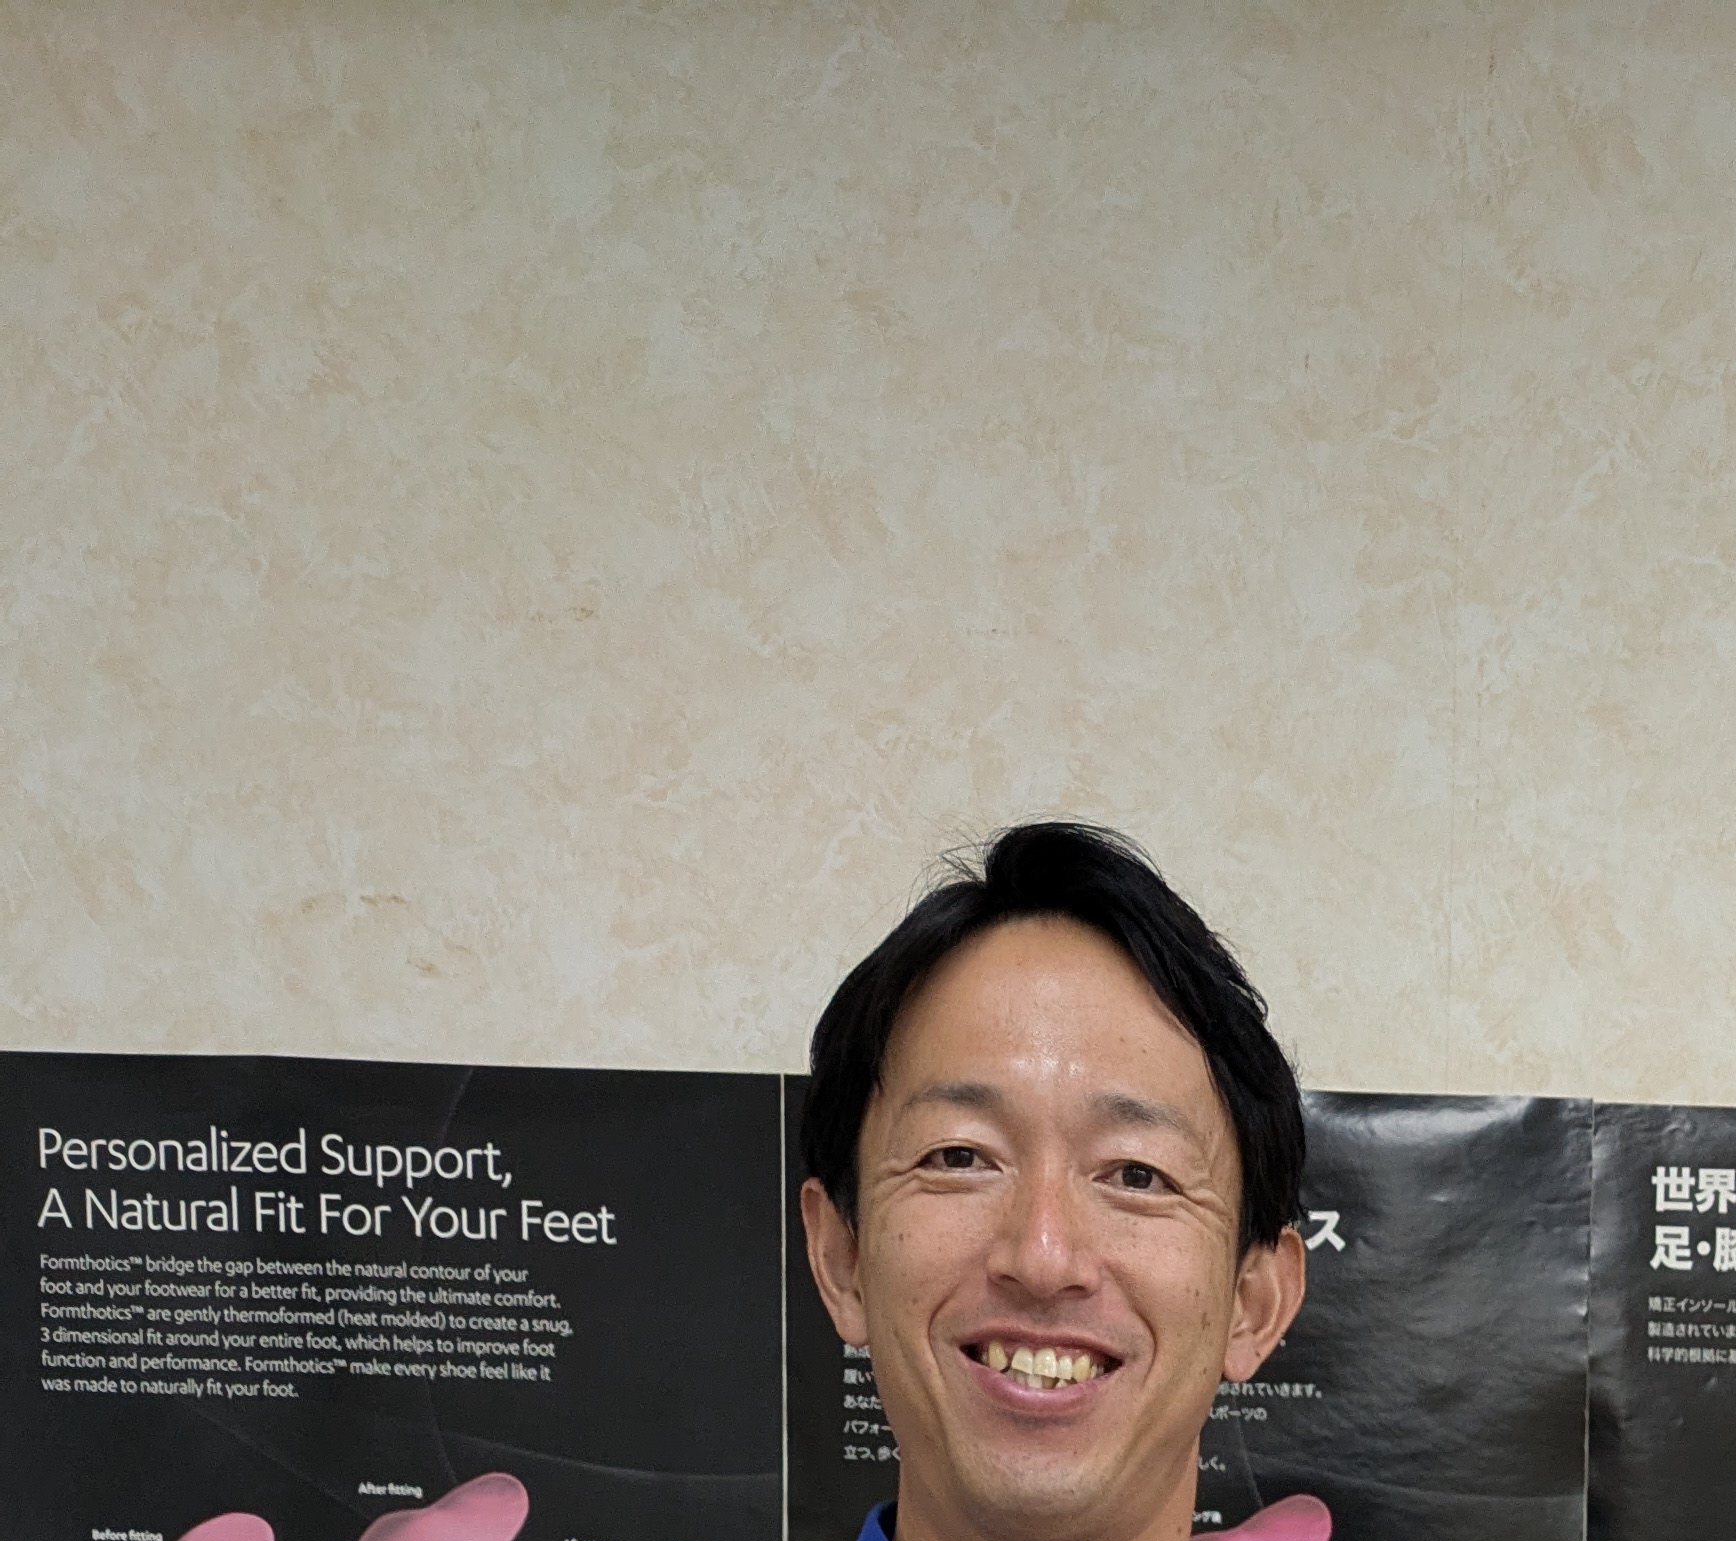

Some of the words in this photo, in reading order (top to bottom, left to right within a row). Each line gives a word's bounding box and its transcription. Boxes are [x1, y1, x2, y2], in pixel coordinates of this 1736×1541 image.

[38, 1125, 307, 1174] Personalized
[320, 1133, 512, 1189] Support,
[37, 1187, 73, 1229] A
[85, 1185, 239, 1232] Natural
[255, 1190, 306, 1234] Fit
[319, 1193, 392, 1236] For
[401, 1196, 507, 1240] Your
[521, 1200, 618, 1245] Feet
[1305, 1210, 1346, 1252] ス
[146, 1254, 194, 1278] bridge
[197, 1254, 222, 1273] the
[225, 1260, 254, 1279] gap
[256, 1256, 323, 1276] between
[326, 1258, 352, 1277] the
[354, 1259, 407, 1278] natural
[410, 1264, 471, 1280] contour
[474, 1263, 490, 1281] of
[493, 1268, 529, 1284] your
[40, 1276, 73, 1295] foot
[76, 1277, 104, 1295] and
[107, 1283, 142, 1301] your
[144, 1278, 212, 1298] footwear
[214, 1280, 236, 1298] for
[239, 1286, 248, 1298] a
[252, 1281, 298, 1300] better
[301, 1282, 321, 1303] fit,
[325, 1283, 397, 1308] providing
[400, 1285, 426, 1304] the
[429, 1286, 491, 1306] ultimate
[494, 1288, 560, 1308] comfort.
[147, 1308, 172, 1321] are
[174, 1303, 221, 1327] gently
[223, 1304, 334, 1325] thermoformed
[338, 1307, 378, 1331] (heat
[381, 1309, 446, 1329] molded)
[448, 1313, 466, 1329] to
[469, 1313, 517, 1331] create
[520, 1318, 529, 1332] a
[532, 1319, 573, 1339] snug,
[40, 1325, 50, 1342] 3
[52, 1325, 144, 1344] dimensional
[146, 1327, 163, 1345] fit
[166, 1328, 219, 1346] around
[222, 1334, 256, 1352] your
[259, 1330, 304, 1349] entire
[306, 1331, 342, 1353] foot,
[345, 1332, 390, 1351] which
[393, 1334, 434, 1357] helps
[436, 1337, 454, 1353] to
[457, 1336, 520, 1360] improve
[523, 1338, 555, 1356] foot
[41, 1349, 106, 1368] function
[109, 1351, 137, 1369] and
[140, 1352, 241, 1376] performance.
[350, 1357, 391, 1375] make
[394, 1363, 437, 1382] every
[440, 1359, 477, 1378] shoe
[480, 1360, 508, 1380] feel
[511, 1361, 538, 1381] like
[540, 1362, 550, 1381] it
[41, 1379, 71, 1391] was
[74, 1374, 118, 1393] made
[120, 1377, 138, 1393] to
[140, 1375, 204, 1400] naturally
[206, 1377, 222, 1395] fit
[225, 1383, 260, 1401] your
[263, 1379, 298, 1397] foot.
[358, 1481, 386, 1496] After
[387, 1483, 424, 1500] fitting
[91, 1528, 127, 1541] Before
